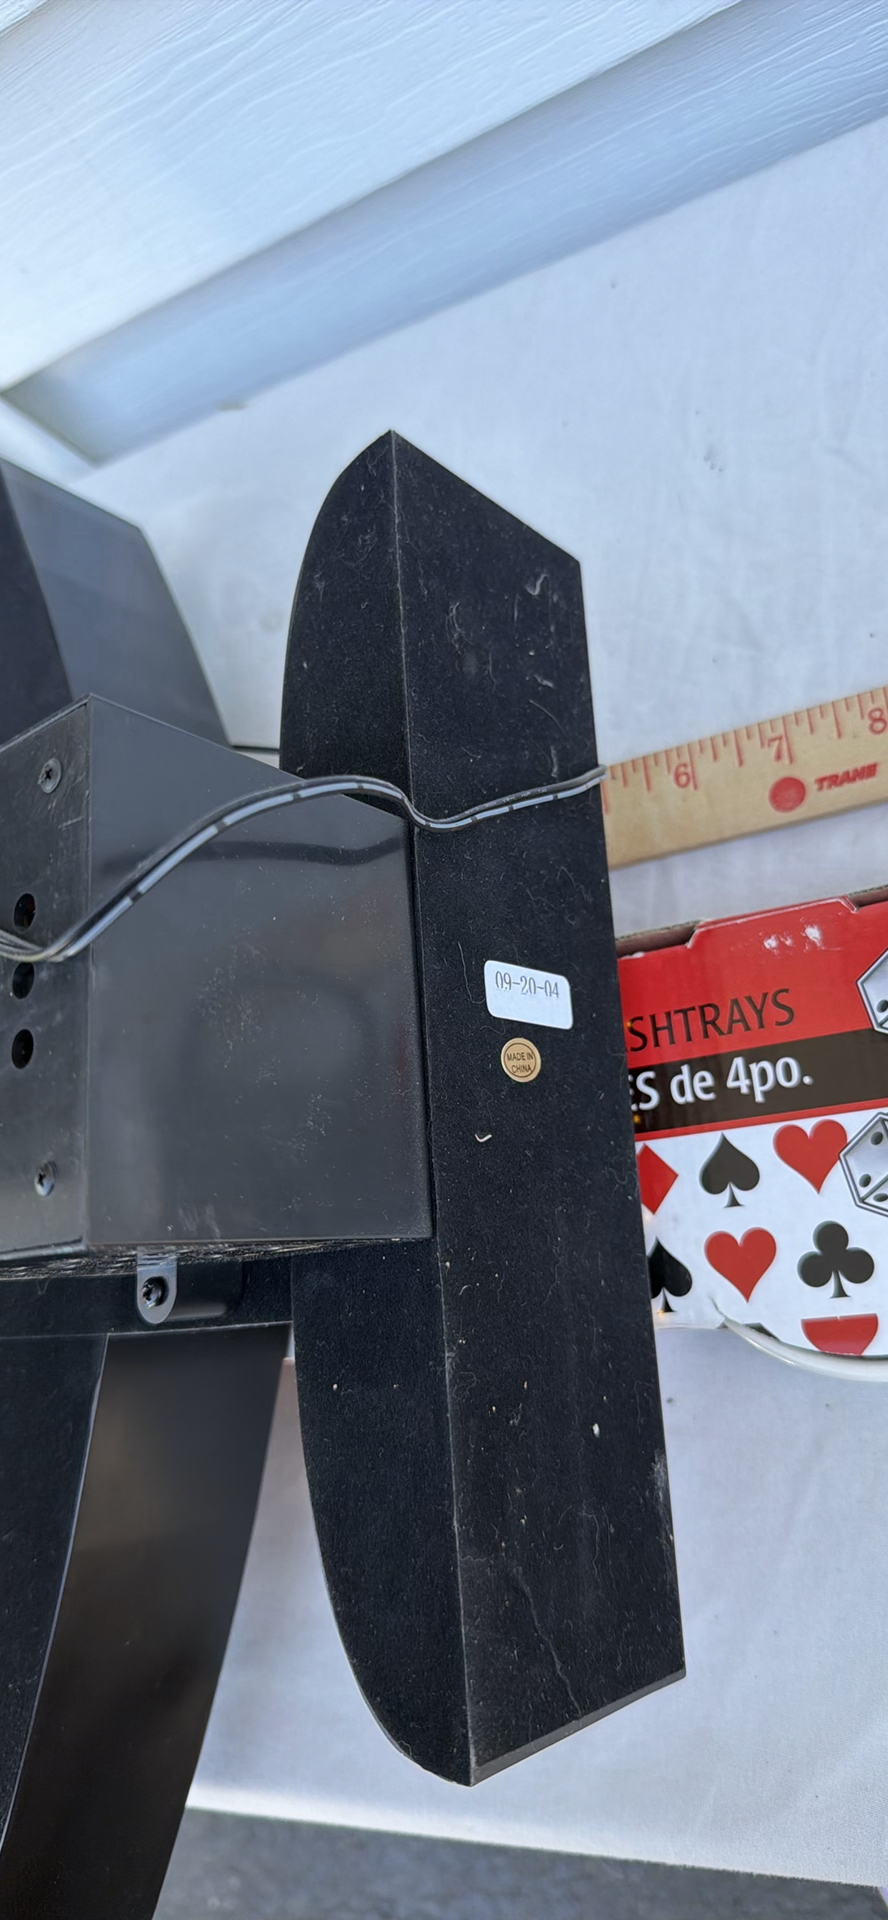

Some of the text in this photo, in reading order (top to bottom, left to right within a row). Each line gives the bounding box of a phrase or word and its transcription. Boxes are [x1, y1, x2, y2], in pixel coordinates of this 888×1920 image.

[673, 707, 887, 788] 6 7 8
[814, 763, 878, 791] TRANE
[495, 971, 559, 998] 09-20-04
[624, 988, 795, 1053] SHTRAYS
[506, 1052, 534, 1061] MADE IN
[511, 1064, 532, 1073] CHINA
[669, 1064, 717, 1106] de
[726, 1056, 814, 1104] 4po.
